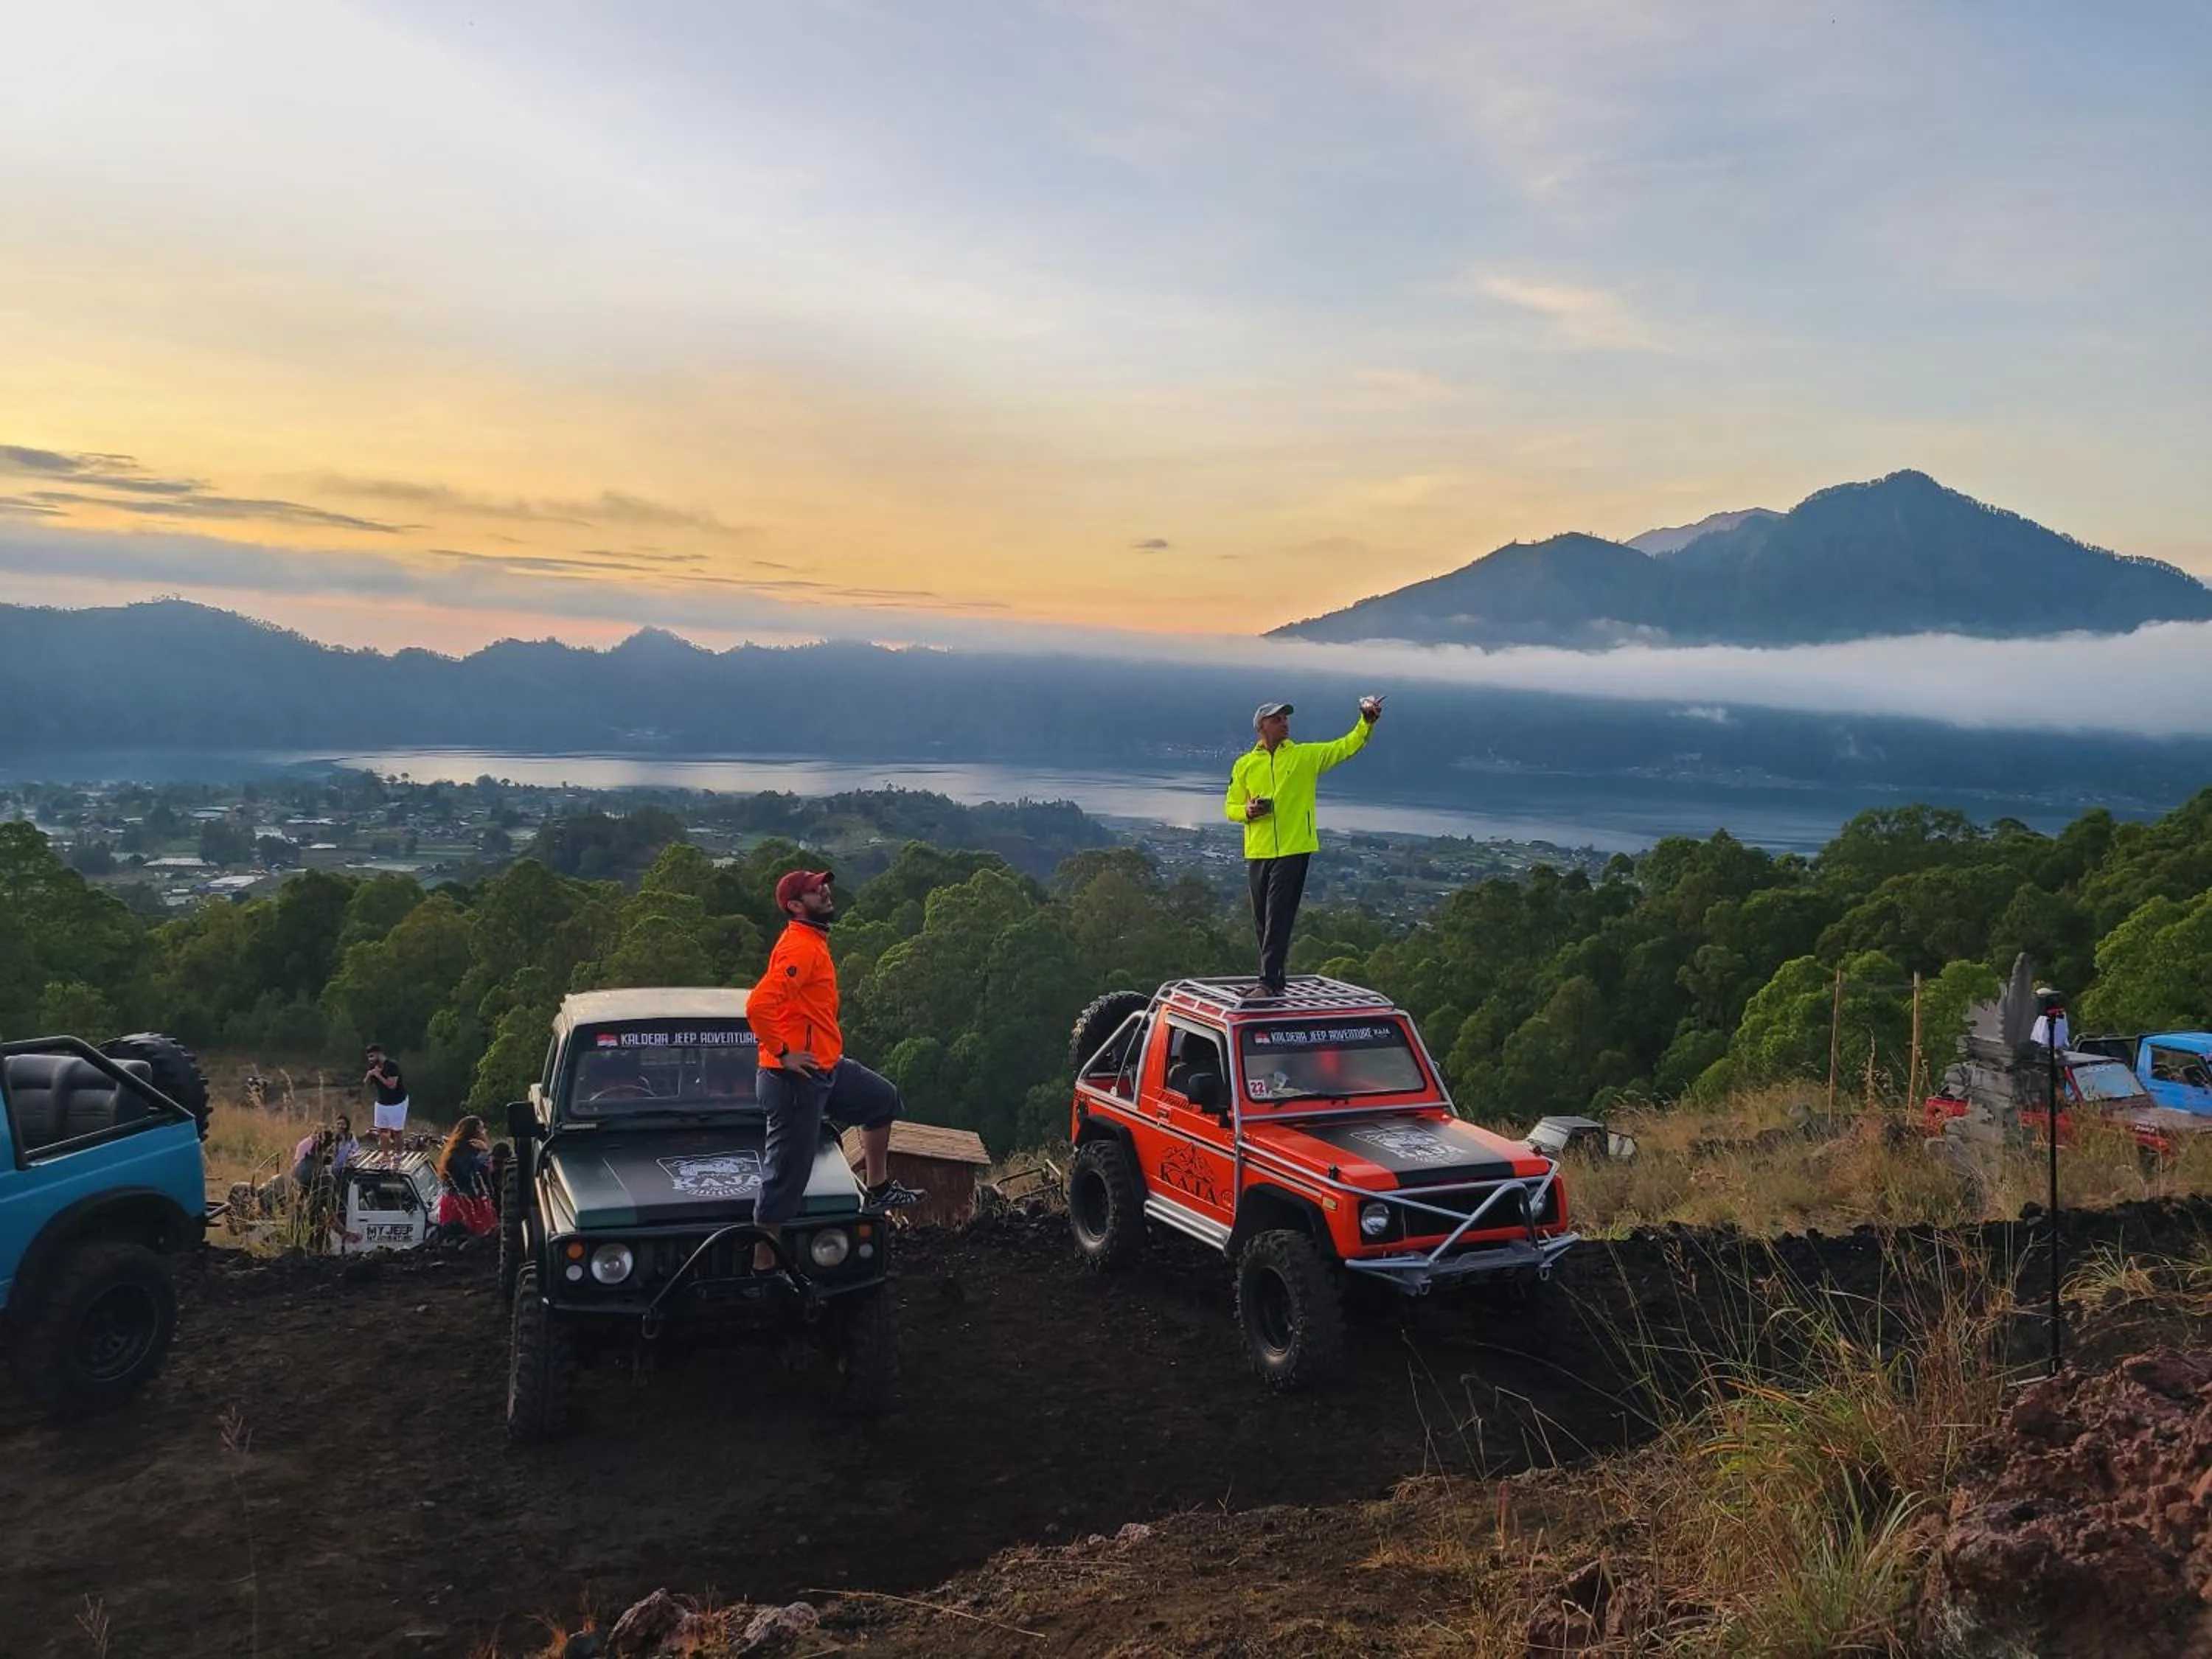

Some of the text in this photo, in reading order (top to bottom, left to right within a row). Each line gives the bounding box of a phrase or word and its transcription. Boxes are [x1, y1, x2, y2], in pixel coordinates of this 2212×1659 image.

[620, 1033, 668, 1045] KALDERA
[672, 1032, 697, 1043] JEEP
[1310, 1030, 1326, 1042] JEEP
[1250, 1082, 1265, 1093] 22
[672, 1174, 763, 1190] KAJA
[1161, 1161, 1218, 1206] KAJA
[386, 1226, 413, 1235] JEEP
